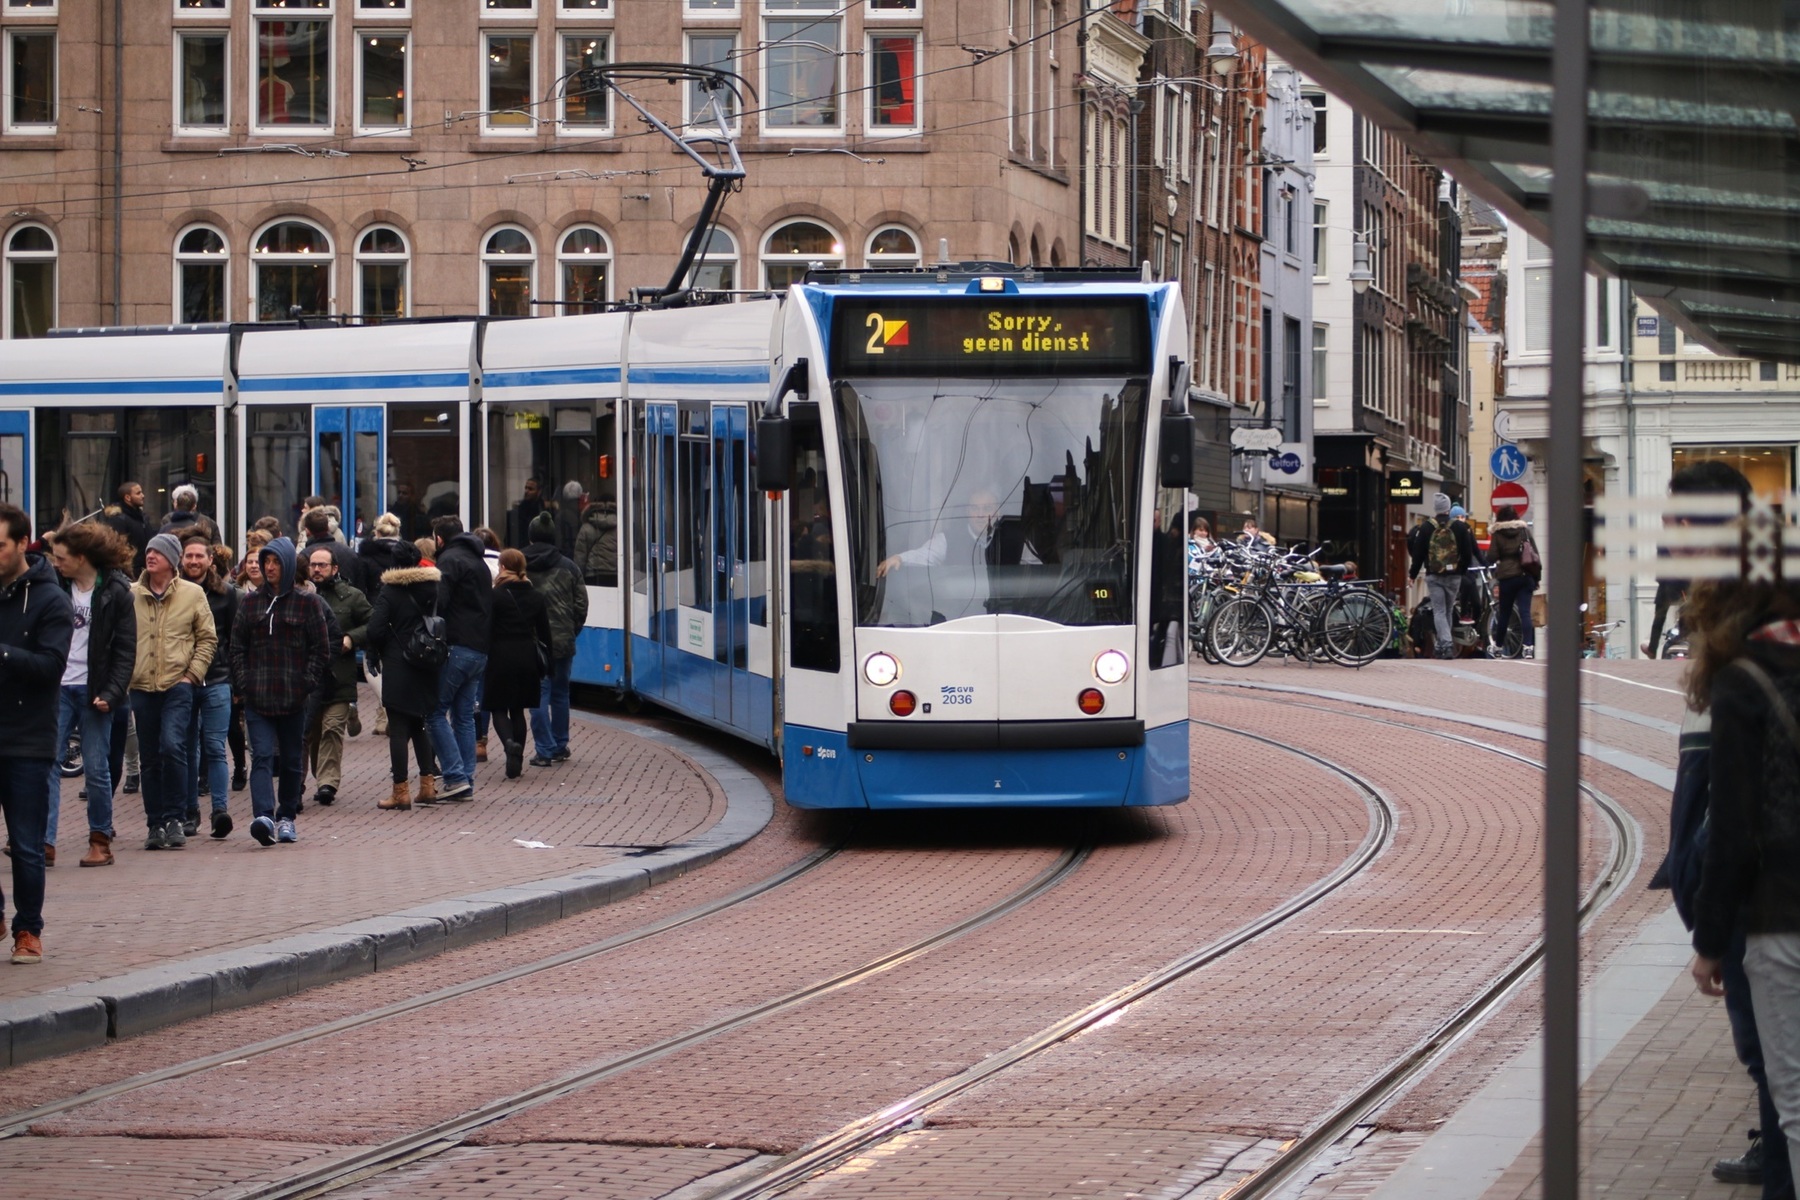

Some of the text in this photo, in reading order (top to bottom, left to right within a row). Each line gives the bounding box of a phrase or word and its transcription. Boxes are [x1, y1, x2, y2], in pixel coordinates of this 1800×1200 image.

[988, 312, 1062, 331] Sorry,
[865, 313, 884, 354] 2
[963, 332, 1090, 353] geen dienst
[1094, 589, 1108, 599] 10
[942, 694, 972, 705] 2036
